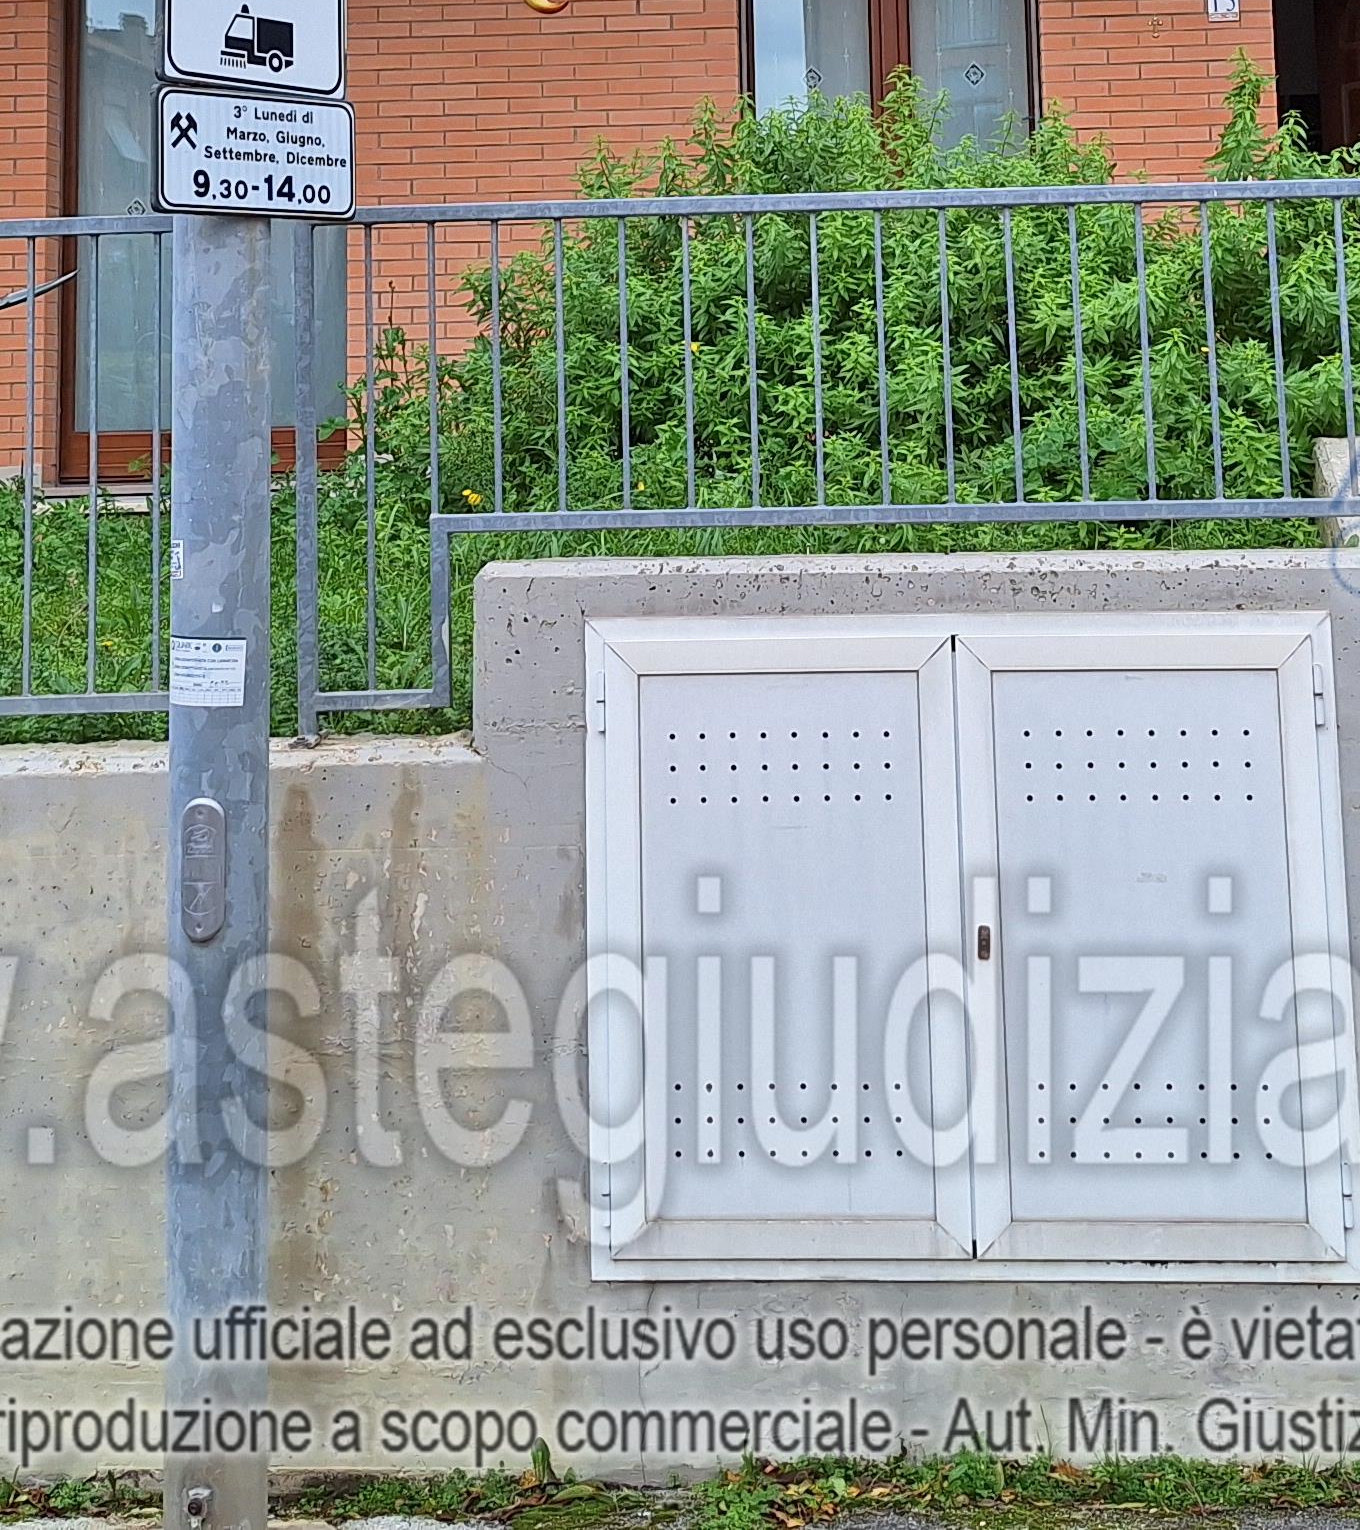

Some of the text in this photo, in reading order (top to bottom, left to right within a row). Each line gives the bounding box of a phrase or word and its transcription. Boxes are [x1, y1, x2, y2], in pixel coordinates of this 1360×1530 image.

[226, 126, 326, 149] Marzo, Giugno,
[204, 145, 347, 168] Settembre, Dicembre
